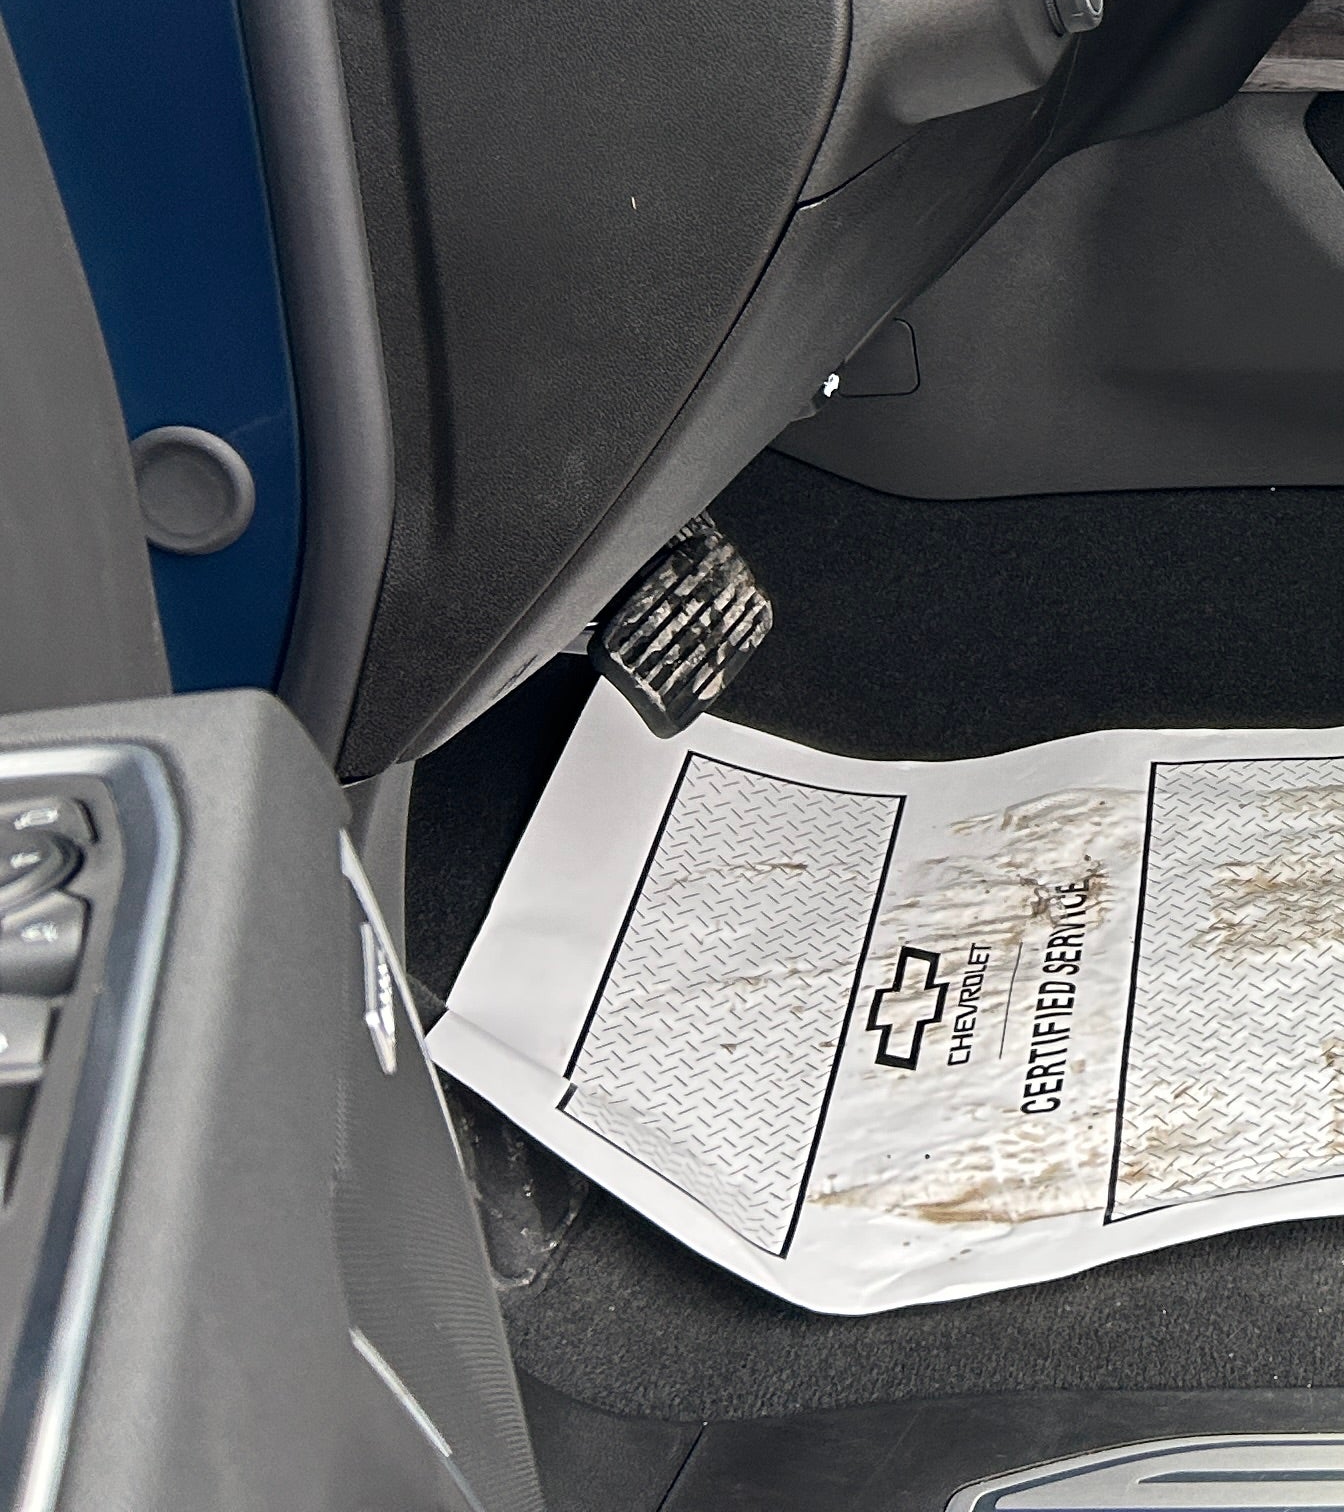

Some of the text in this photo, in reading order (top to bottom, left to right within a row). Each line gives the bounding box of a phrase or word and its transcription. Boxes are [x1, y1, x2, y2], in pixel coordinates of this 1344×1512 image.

[947, 942, 992, 1067] CHEVROLET
[1020, 878, 1091, 1115] CERTIFIED SERVICE
